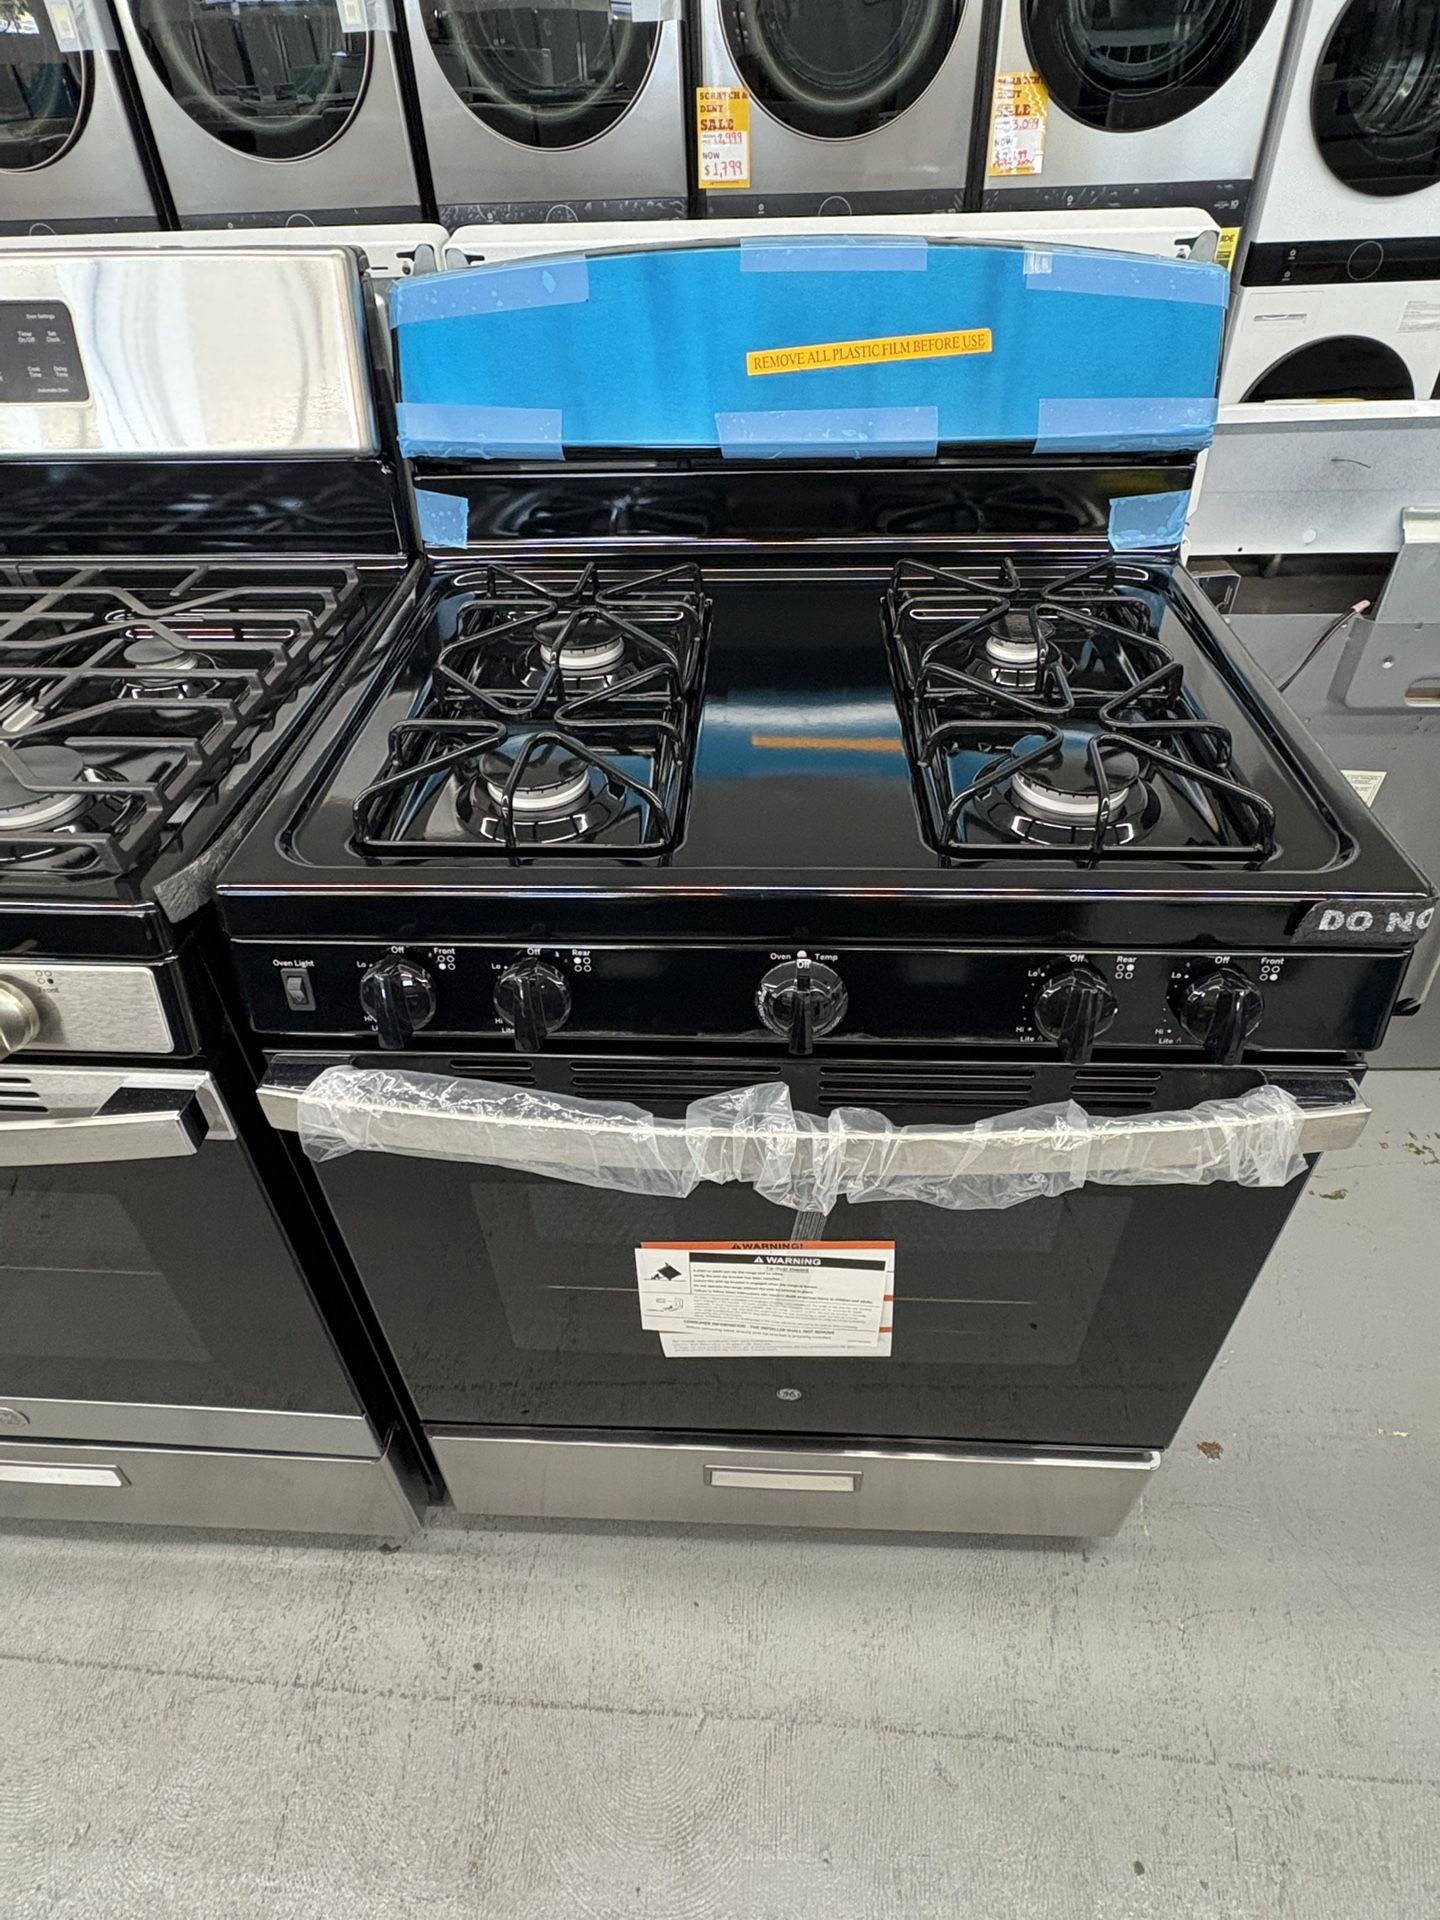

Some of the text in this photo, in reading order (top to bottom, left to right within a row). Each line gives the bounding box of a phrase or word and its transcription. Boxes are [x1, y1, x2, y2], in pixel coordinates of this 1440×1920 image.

[700, 91, 740, 100] SCRATCH
[700, 104, 724, 113] DENT
[700, 119, 734, 131] SALE
[702, 152, 720, 160] NOW
[753, 333, 986, 371] REMOVE ALL PLASTIC FILM BEFORE USE
[1318, 909, 1374, 932] DO
[433, 947, 456, 955] Front
[527, 948, 541, 956] Off
[814, 953, 839, 963] Temp
[1069, 954, 1085, 963] Off
[1214, 956, 1230, 964] Off
[1260, 957, 1285, 965] Front
[272, 959, 315, 968] Oven Light
[1171, 971, 1182, 979] Lo
[742, 1242, 804, 1250] WARNING!
[766, 1256, 822, 1266] WARNING
